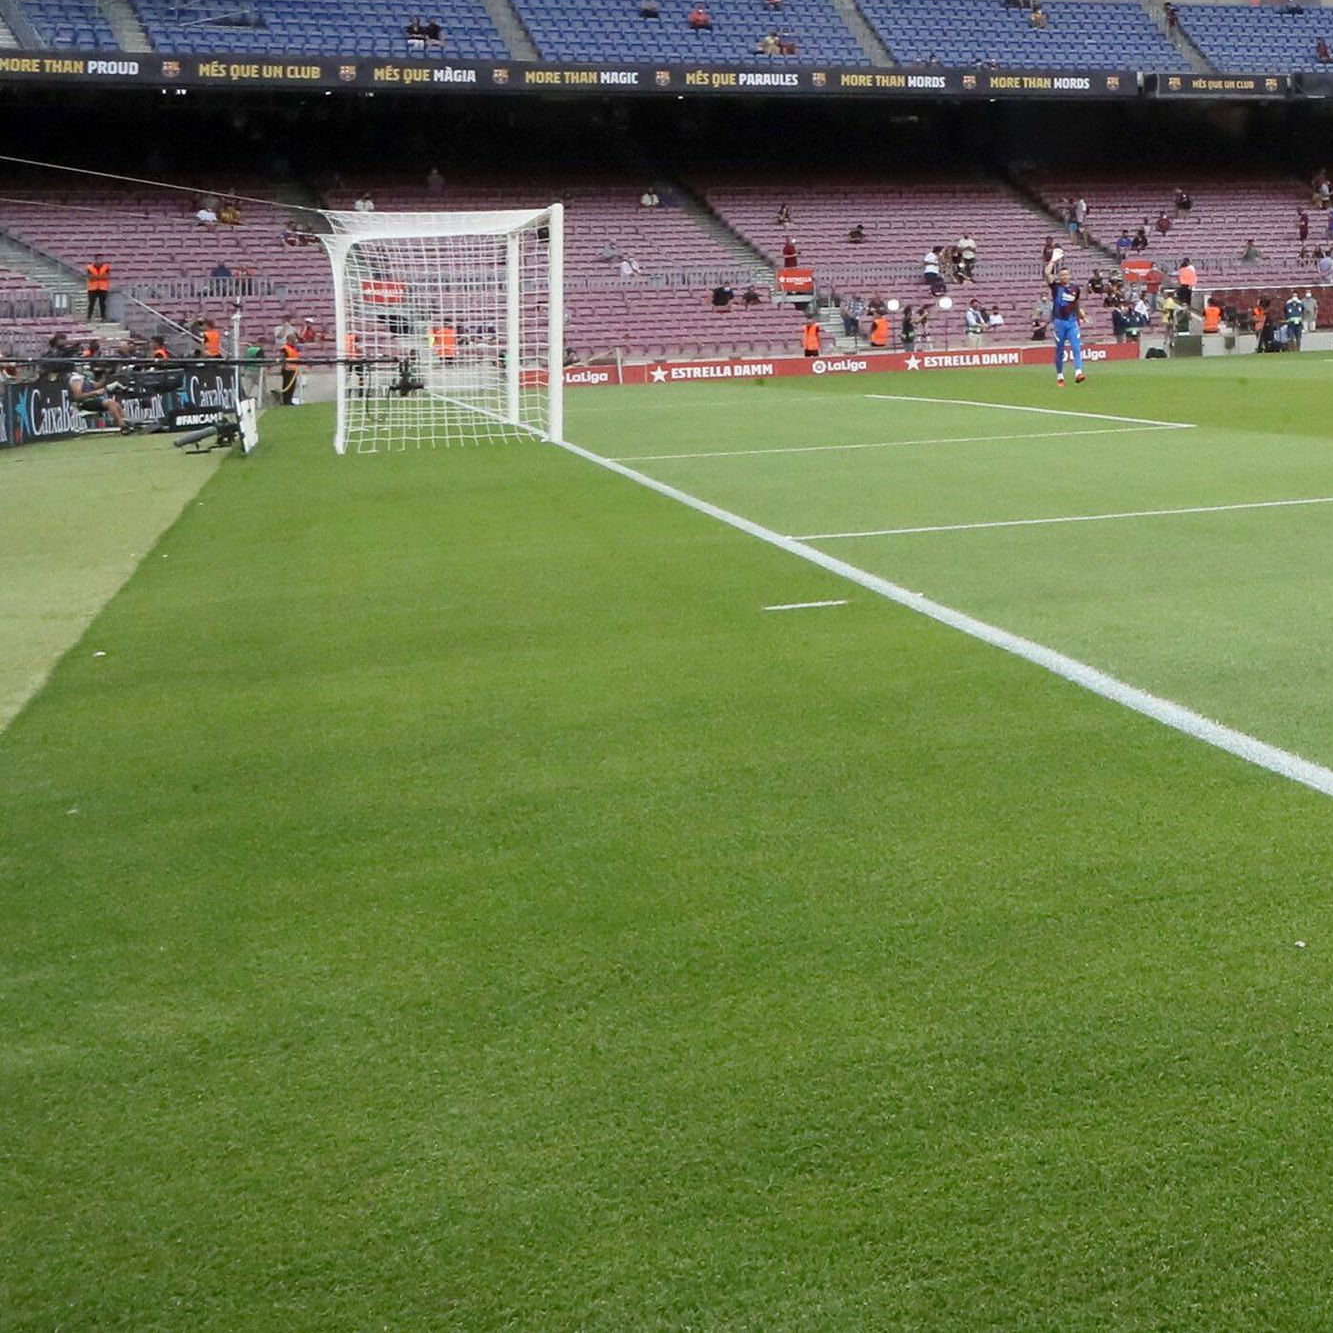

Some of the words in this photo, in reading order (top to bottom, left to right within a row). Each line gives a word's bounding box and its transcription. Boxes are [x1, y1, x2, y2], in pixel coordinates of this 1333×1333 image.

[43, 59, 84, 74] THAN
[87, 60, 139, 76] PROUD
[199, 60, 227, 78] MÉS
[230, 64, 260, 81] QUE
[262, 65, 283, 78] UN
[287, 66, 321, 79] CLUB
[374, 65, 400, 81] MÉS
[403, 68, 430, 84] QUE
[433, 66, 476, 83] MÀGIA
[525, 71, 561, 84] MORE
[563, 71, 597, 84] THAN
[600, 71, 639, 85] MAGIC
[686, 70, 710, 85] MÉS
[712, 72, 737, 88] QUE
[739, 73, 799, 86] PARAULES
[840, 74, 873, 87] MORE
[875, 74, 906, 87] THAN
[907, 75, 946, 88] WORDS
[990, 76, 1020, 89] MORE
[1022, 76, 1051, 89] THAN
[1053, 77, 1090, 90] WORDS
[827, 359, 867, 372] LaLiga
[924, 354, 981, 367] ESTRELLA
[982, 352, 1019, 365] DAMM
[566, 370, 608, 384] LaLiga
[671, 366, 732, 378] ESTRELLA
[734, 363, 774, 376] DAMM
